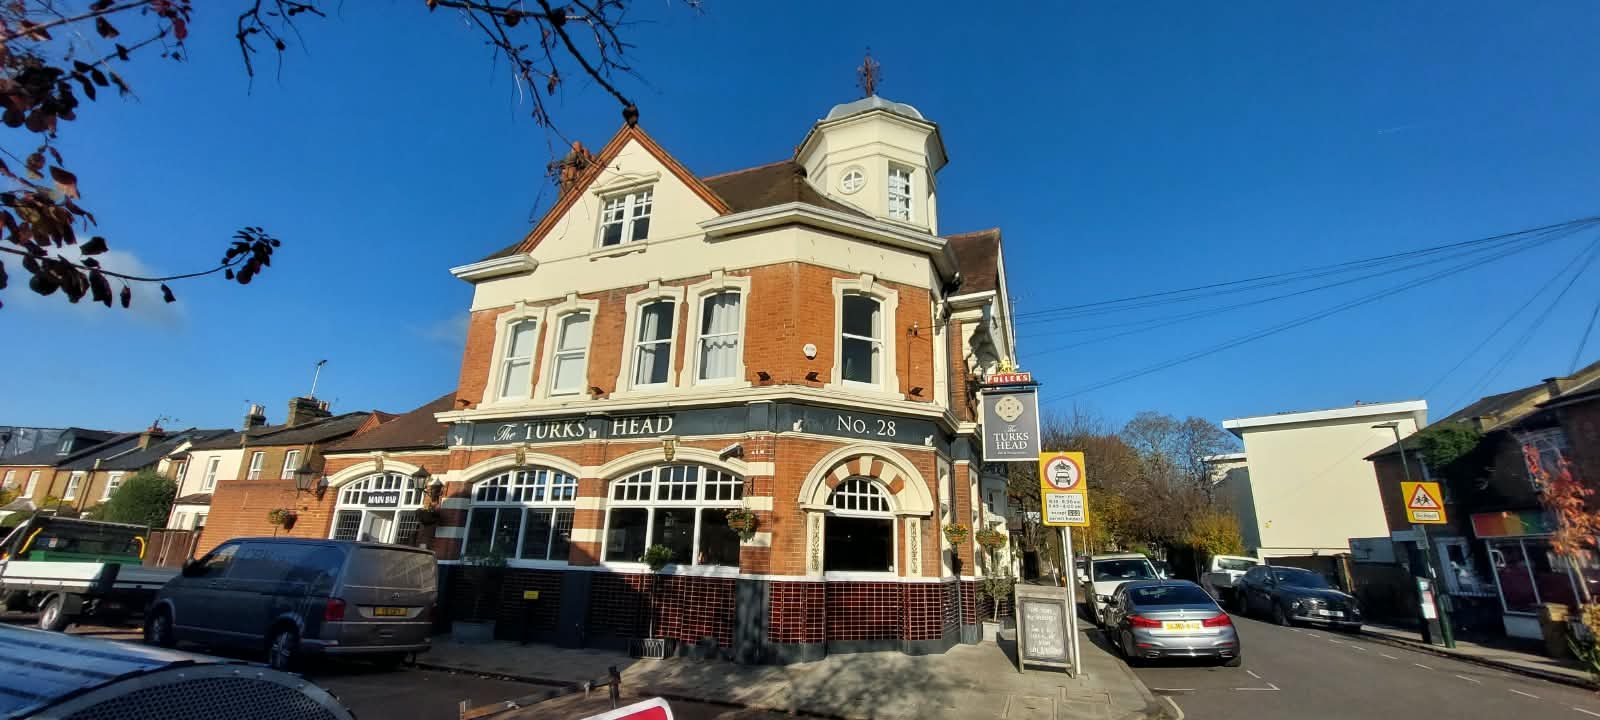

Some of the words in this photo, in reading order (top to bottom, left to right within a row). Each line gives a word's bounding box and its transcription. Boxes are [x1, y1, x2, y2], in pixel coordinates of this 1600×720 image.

[494, 423, 517, 441] The
[523, 421, 585, 440] TURKS
[611, 416, 673, 436] HEAD
[877, 419, 896, 437] 28
[993, 432, 1029, 442] TURKS
[996, 441, 1028, 450] HEAD
